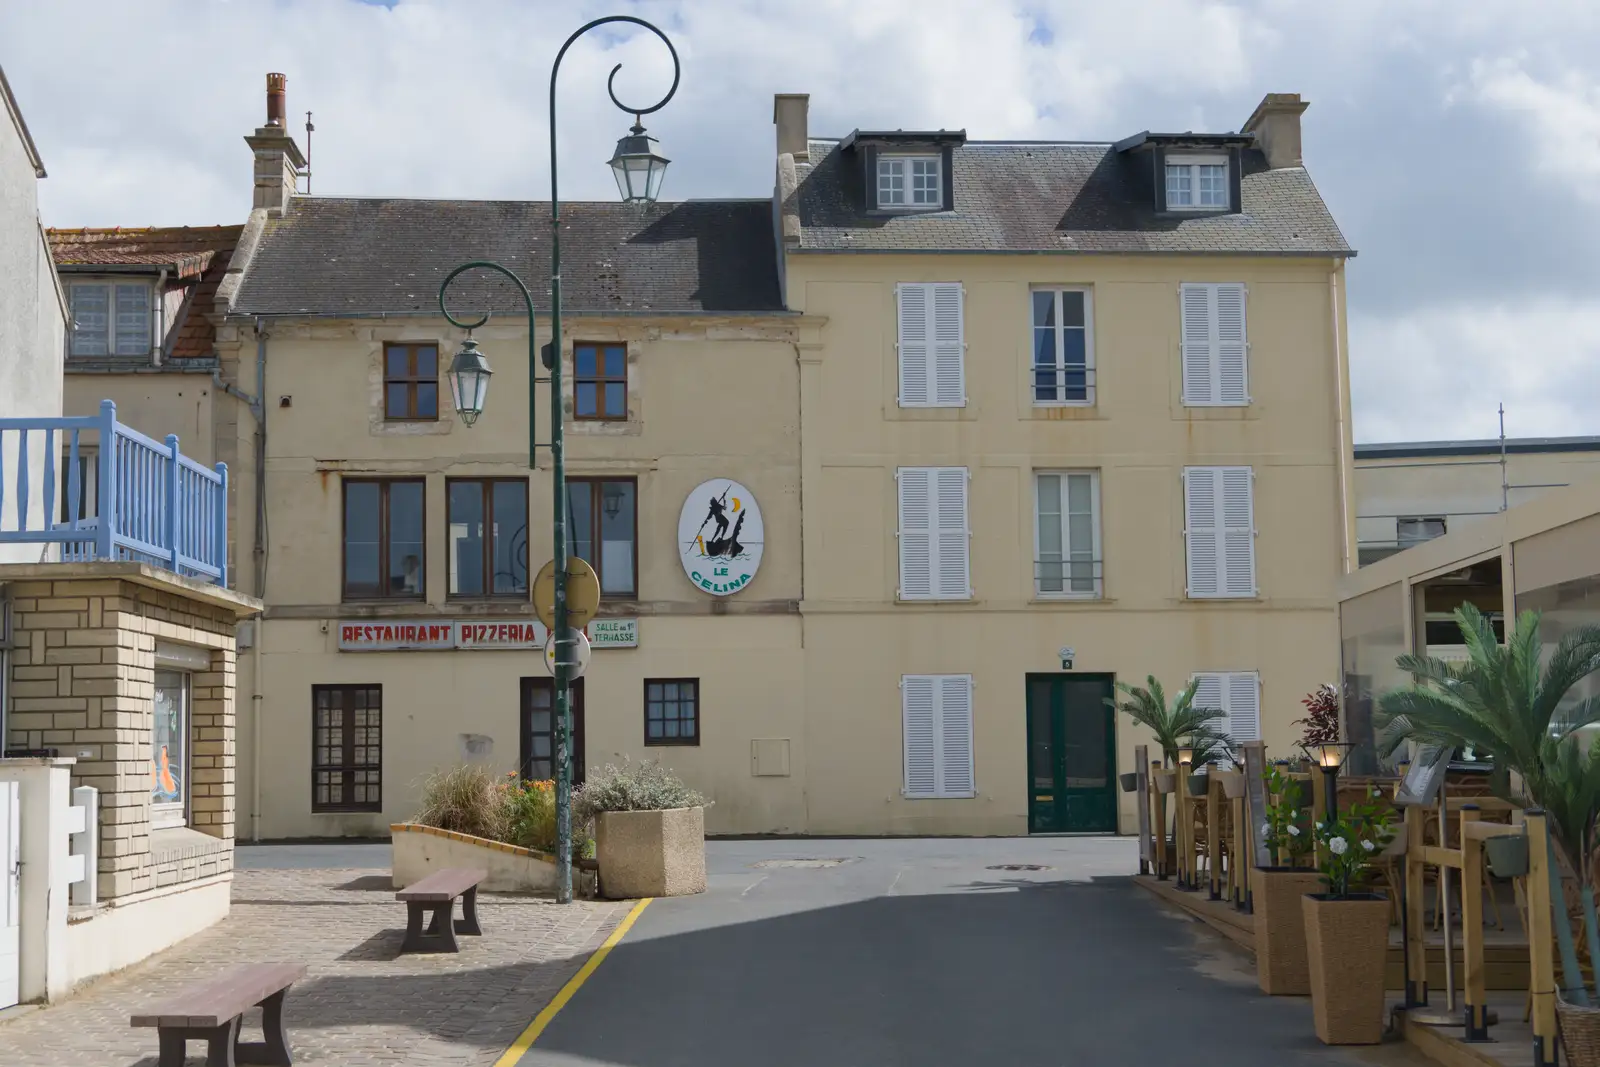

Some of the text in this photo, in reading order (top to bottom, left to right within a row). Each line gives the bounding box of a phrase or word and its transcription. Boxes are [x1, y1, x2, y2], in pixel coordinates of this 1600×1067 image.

[713, 567, 728, 576] LE
[691, 570, 751, 592] CELINA
[342, 624, 451, 643] RESTAURANT
[461, 624, 535, 643] PIZZERIA
[596, 623, 618, 631] SALLE
